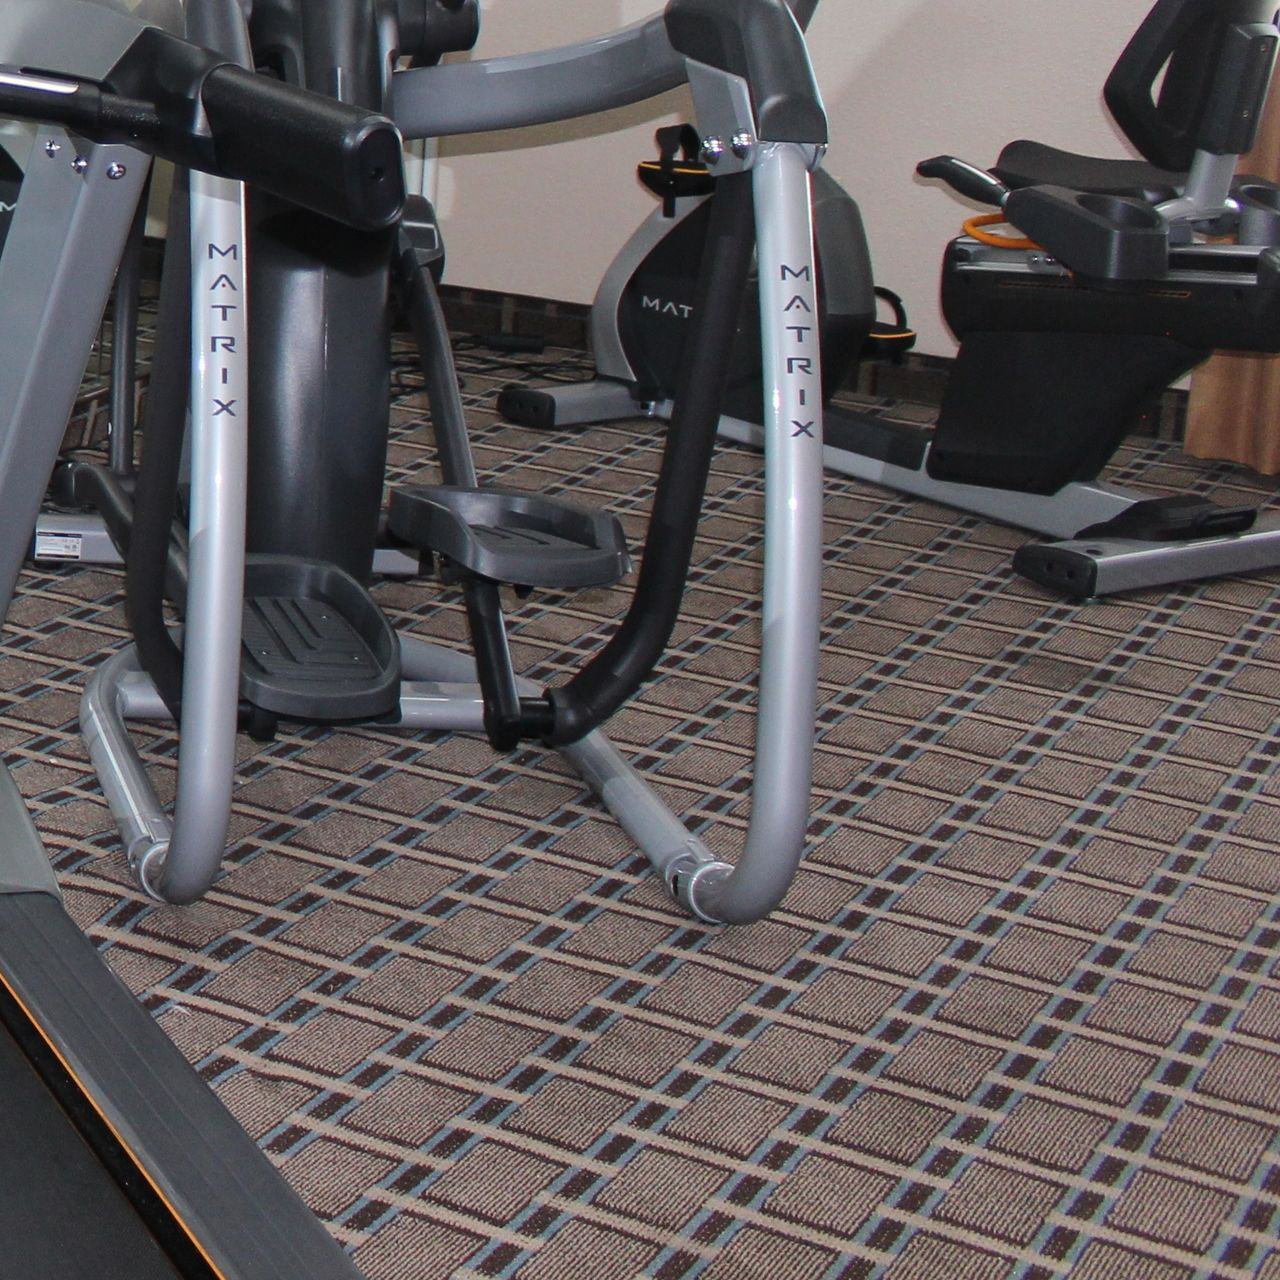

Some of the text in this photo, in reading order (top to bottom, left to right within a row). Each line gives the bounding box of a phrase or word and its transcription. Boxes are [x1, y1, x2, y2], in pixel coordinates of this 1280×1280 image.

[208, 243, 237, 417] MATRIX
[642, 295, 693, 319] MAT
[780, 264, 815, 439] MATRIX
